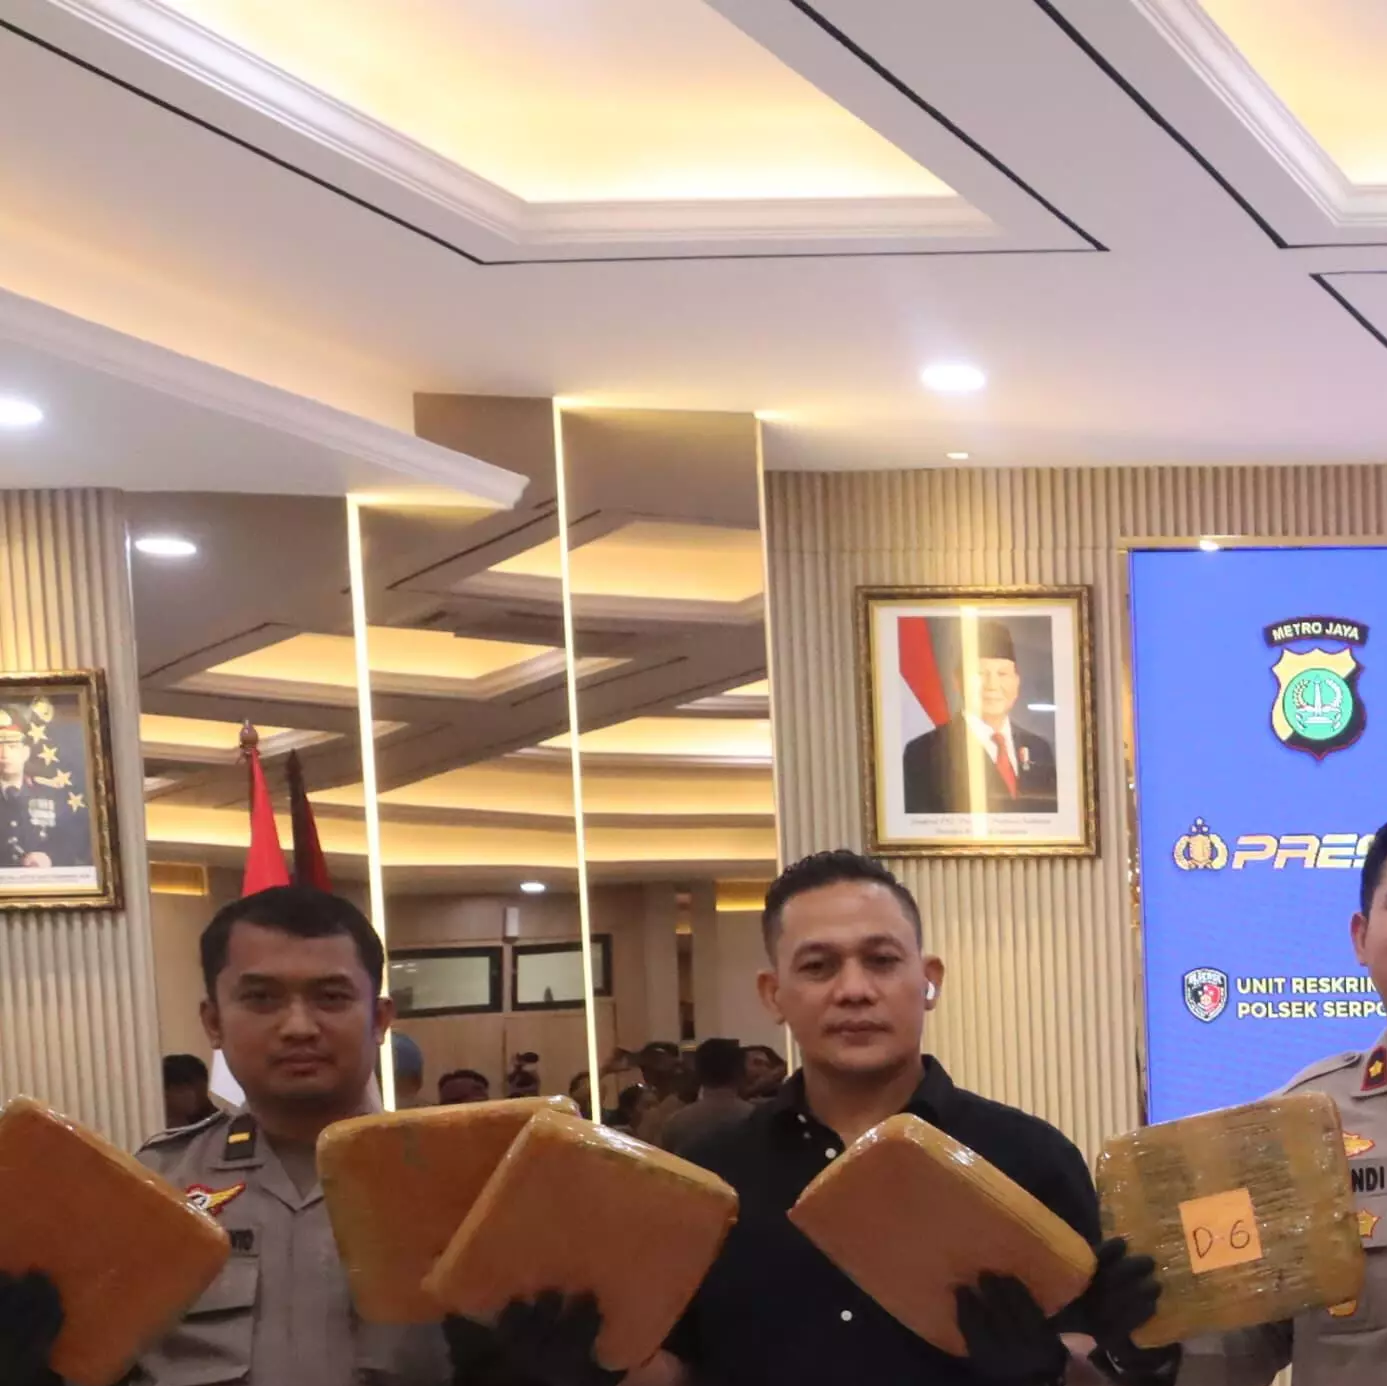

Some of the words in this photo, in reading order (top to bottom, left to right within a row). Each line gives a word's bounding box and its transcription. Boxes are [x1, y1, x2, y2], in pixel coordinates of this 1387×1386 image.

[1271, 621, 1323, 641] METRO
[1324, 622, 1360, 640] JAYA
[1237, 977, 1286, 994] UNIT
[1238, 1001, 1317, 1018] POLSEK
